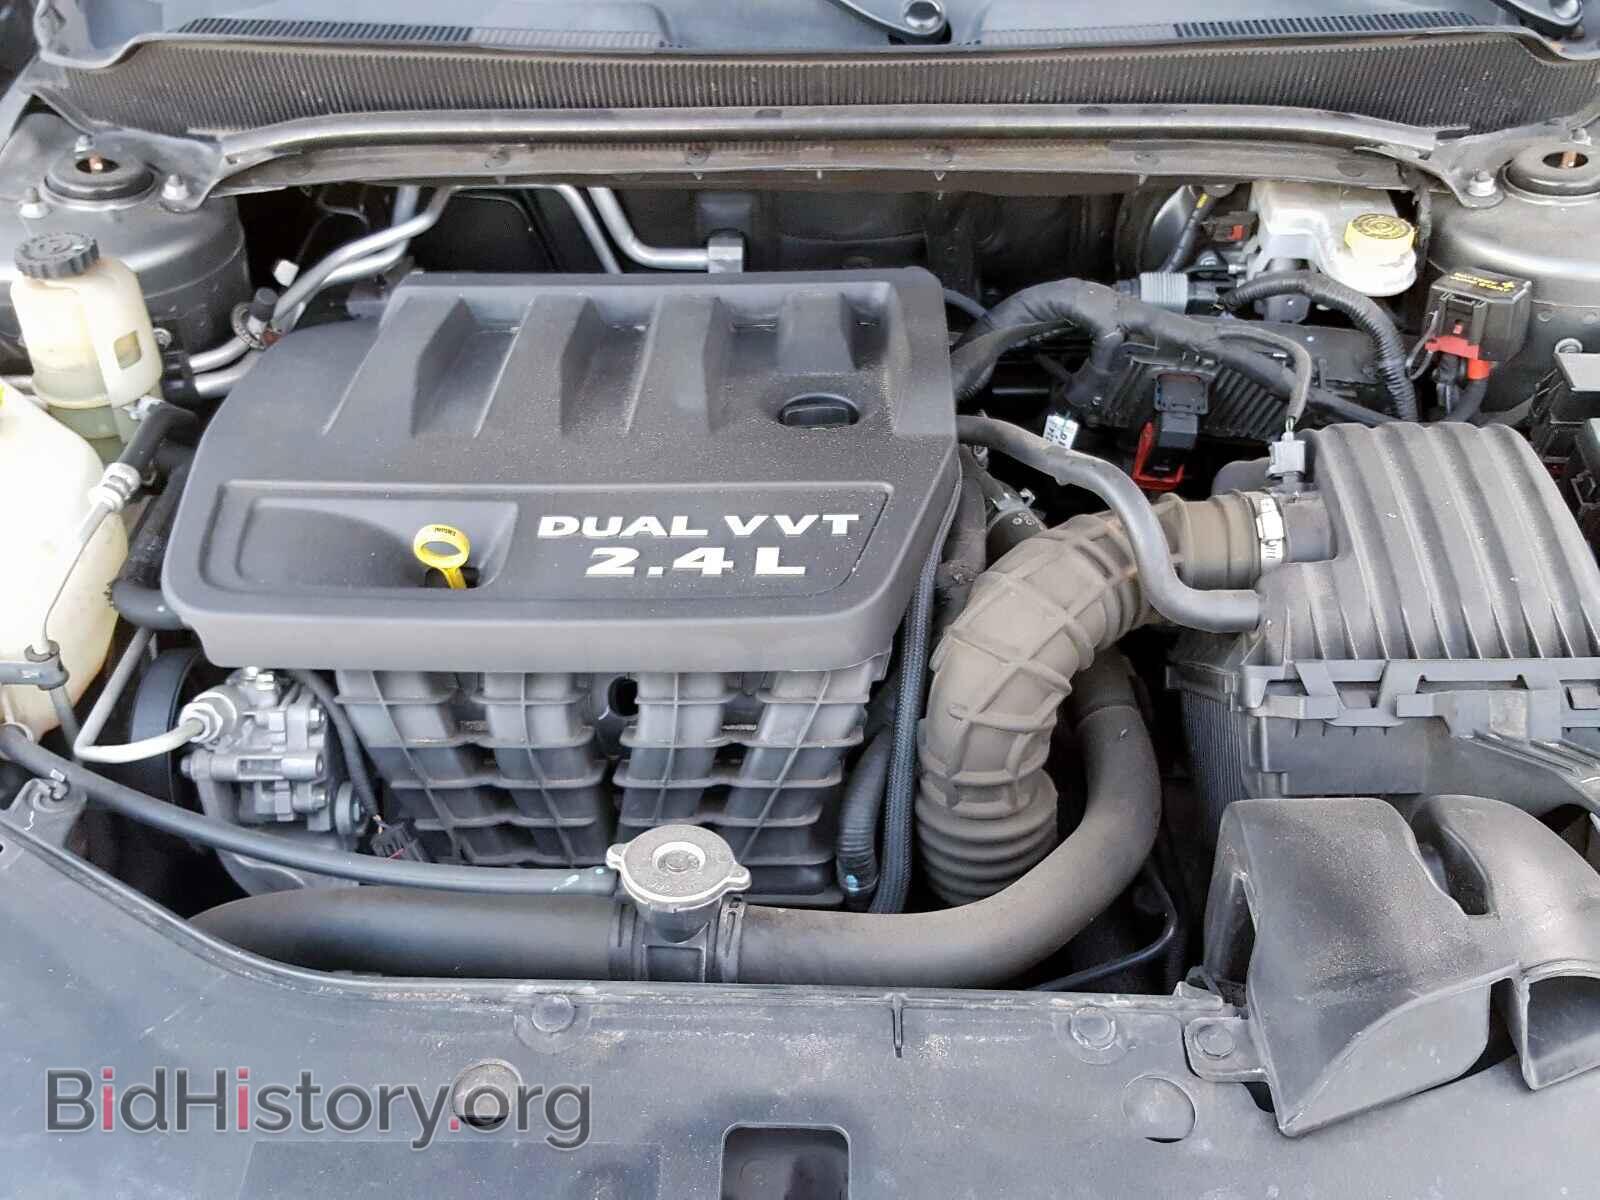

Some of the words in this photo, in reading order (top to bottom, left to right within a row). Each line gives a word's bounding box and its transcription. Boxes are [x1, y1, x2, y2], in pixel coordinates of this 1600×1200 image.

[537, 515, 708, 537] DUAL
[724, 514, 860, 536] VVT
[585, 547, 735, 577] 2.4
[754, 546, 806, 576] L
